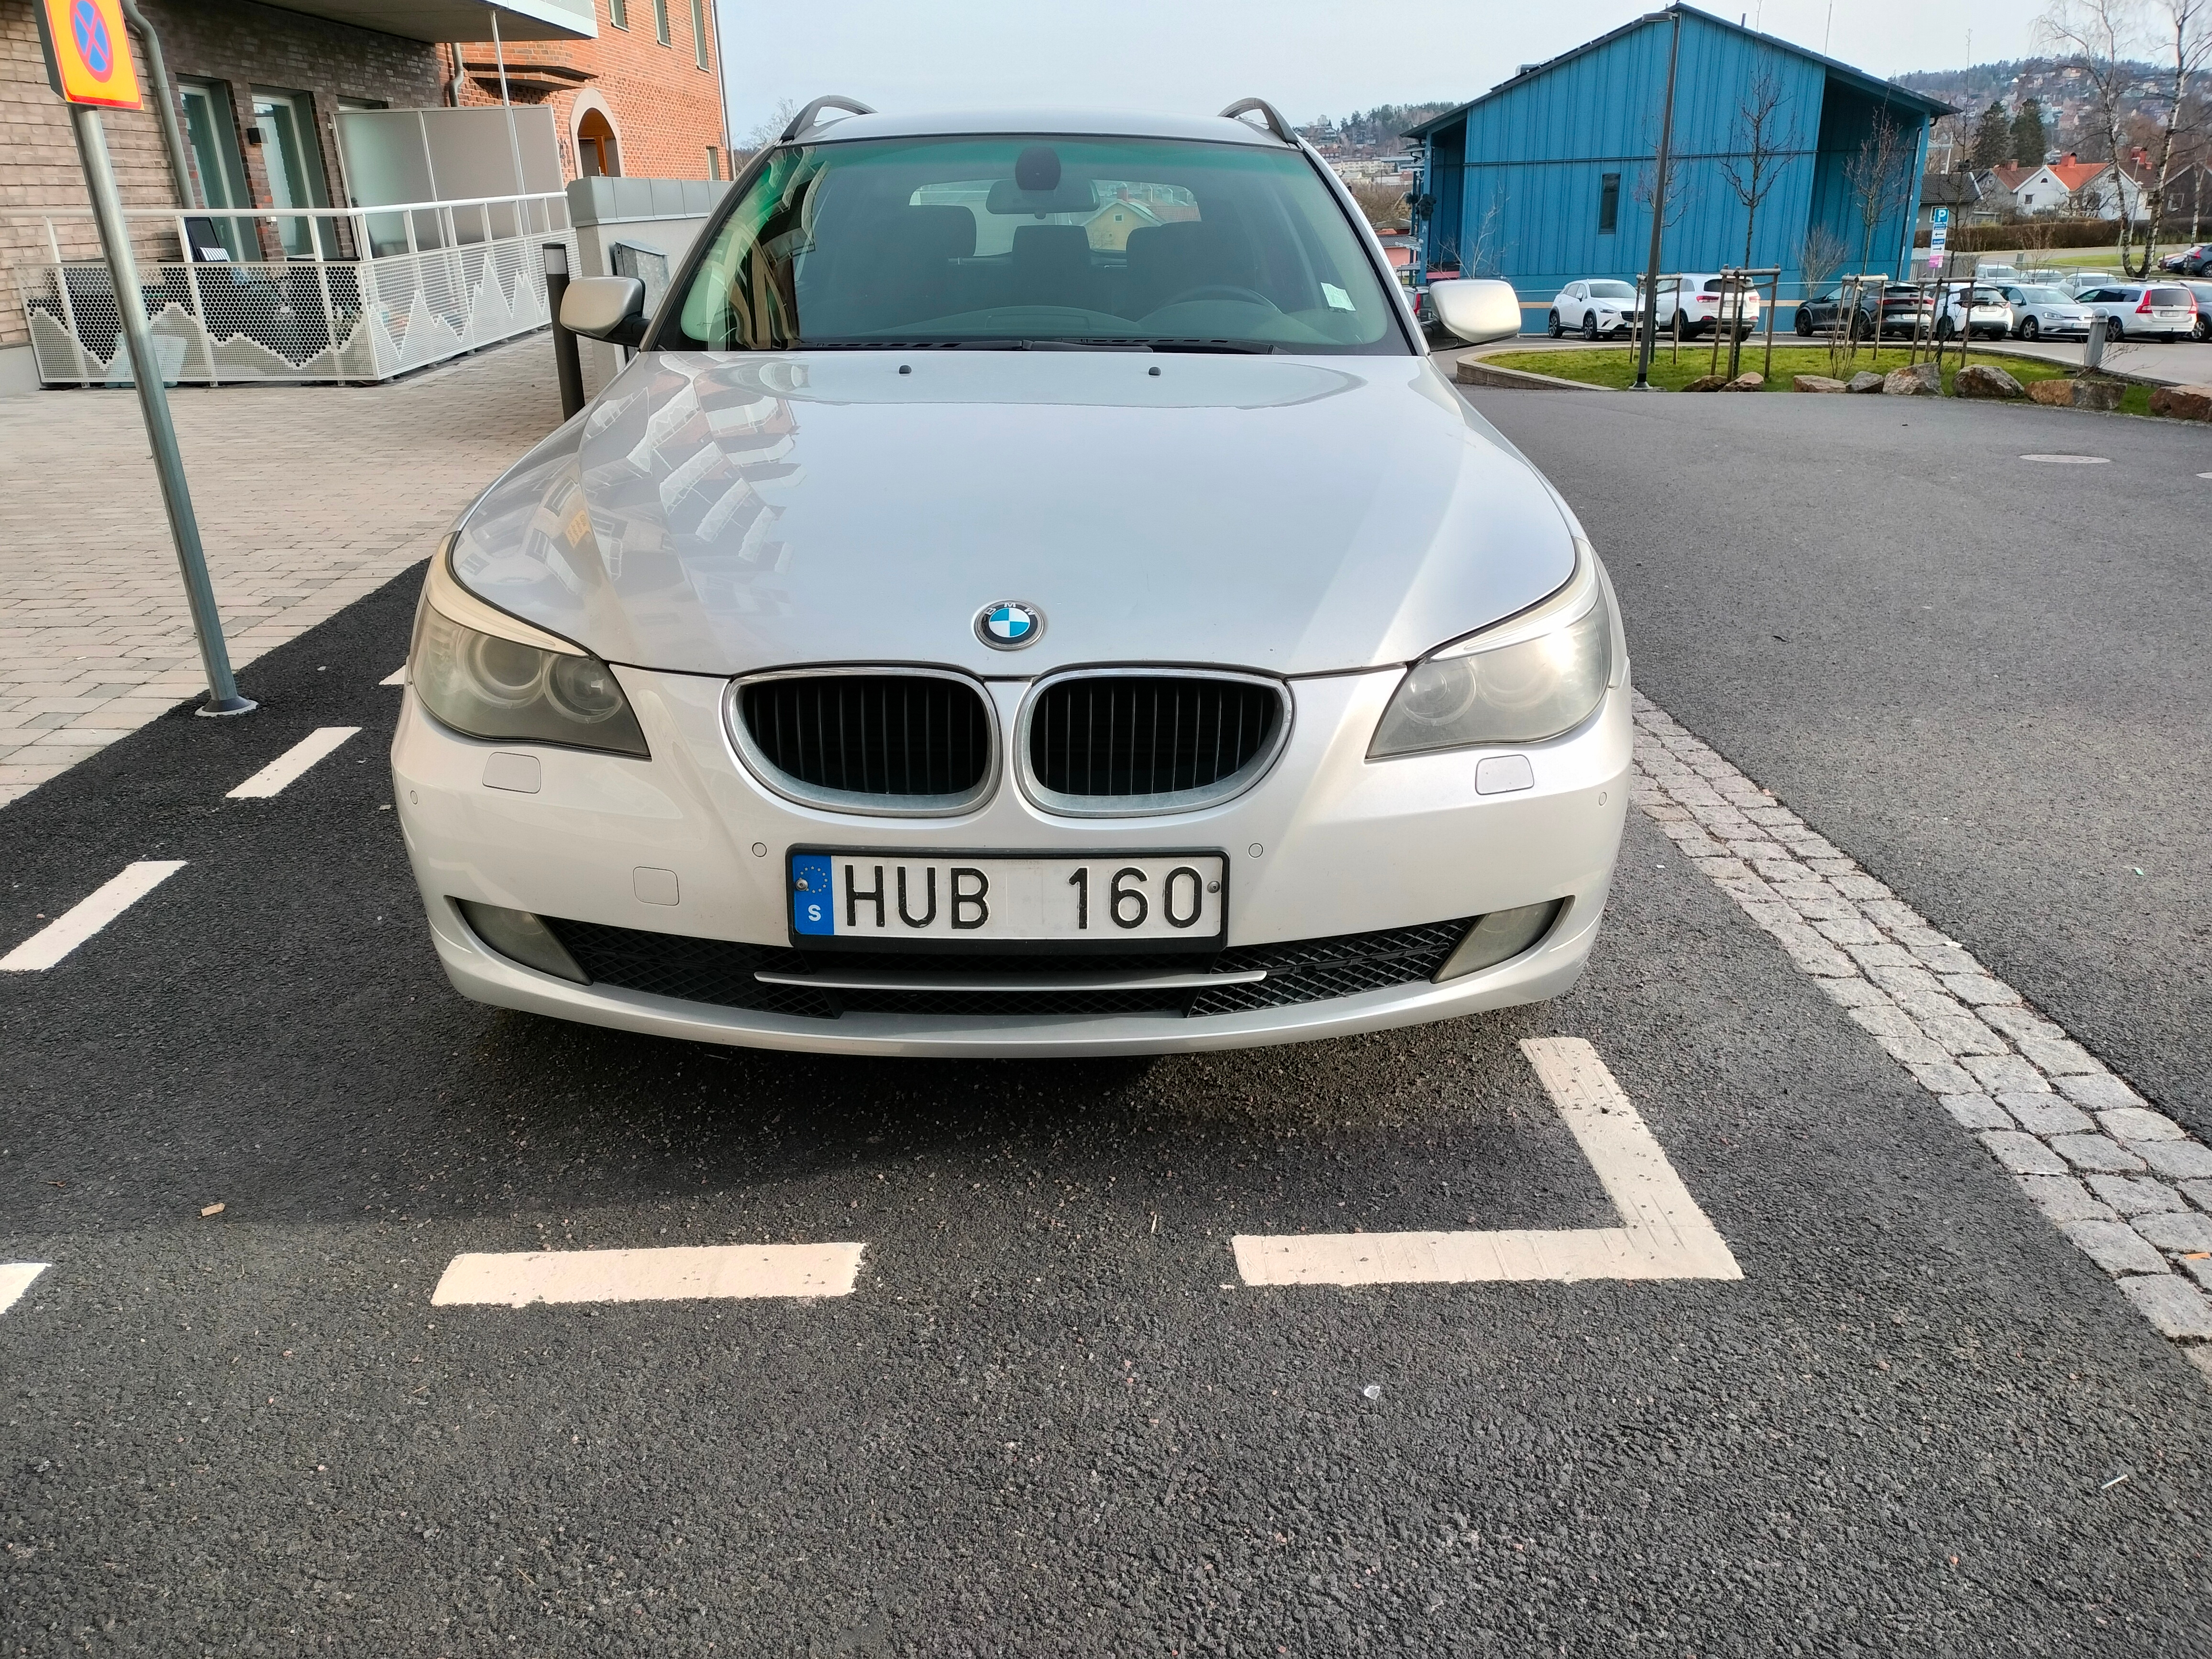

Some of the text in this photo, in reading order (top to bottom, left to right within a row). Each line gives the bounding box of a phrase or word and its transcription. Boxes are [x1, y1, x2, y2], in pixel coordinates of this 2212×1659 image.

[1938, 210, 1947, 222] P
[983, 602, 1036, 616] BMW
[844, 864, 1202, 929] HUB 160
[808, 904, 821, 921] S
